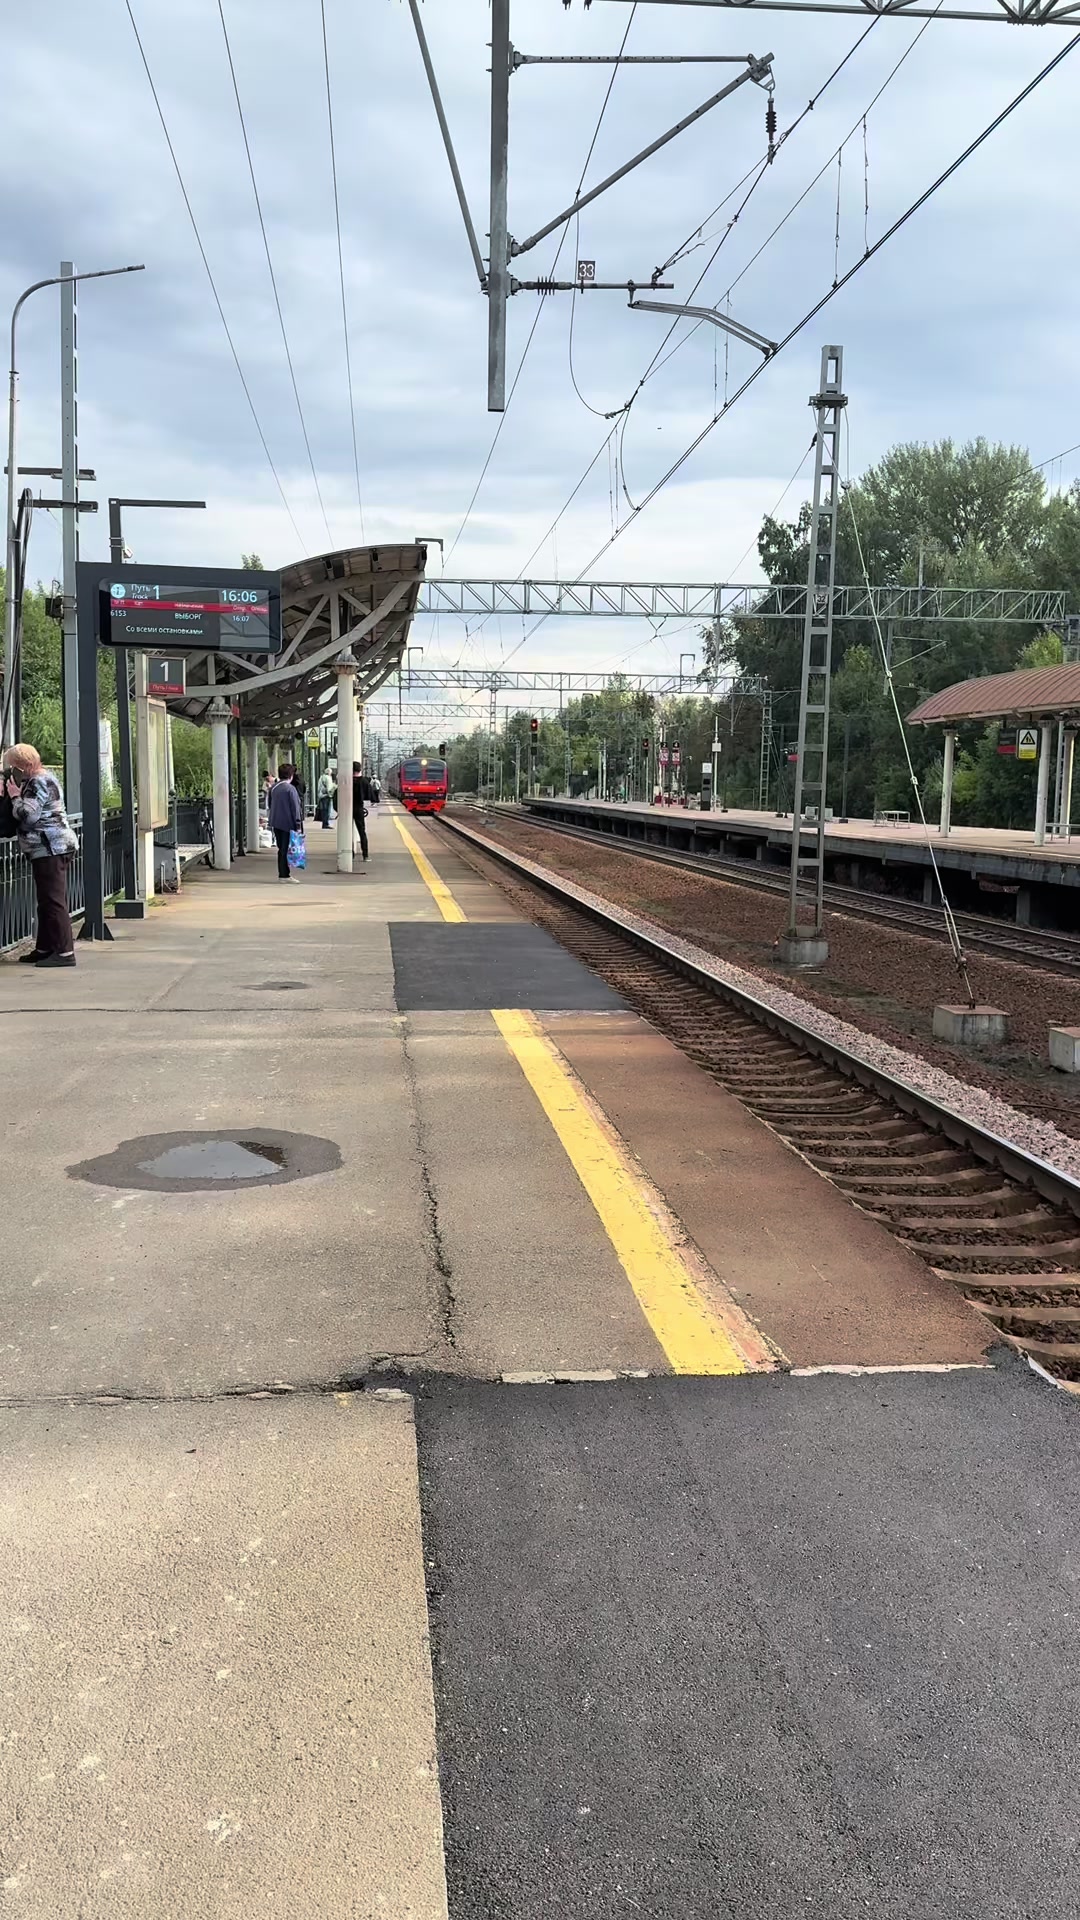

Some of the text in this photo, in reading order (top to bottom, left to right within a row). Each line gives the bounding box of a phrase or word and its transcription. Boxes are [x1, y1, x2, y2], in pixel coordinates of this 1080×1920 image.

[579, 263, 594, 278] 33
[131, 584, 150, 594] Путь
[153, 585, 160, 600] 1
[221, 589, 258, 603] 16:06
[110, 609, 127, 617] 6153
[174, 612, 202, 620] ВЫБОРГ
[232, 615, 250, 623] 16:07
[160, 661, 169, 682] 1
